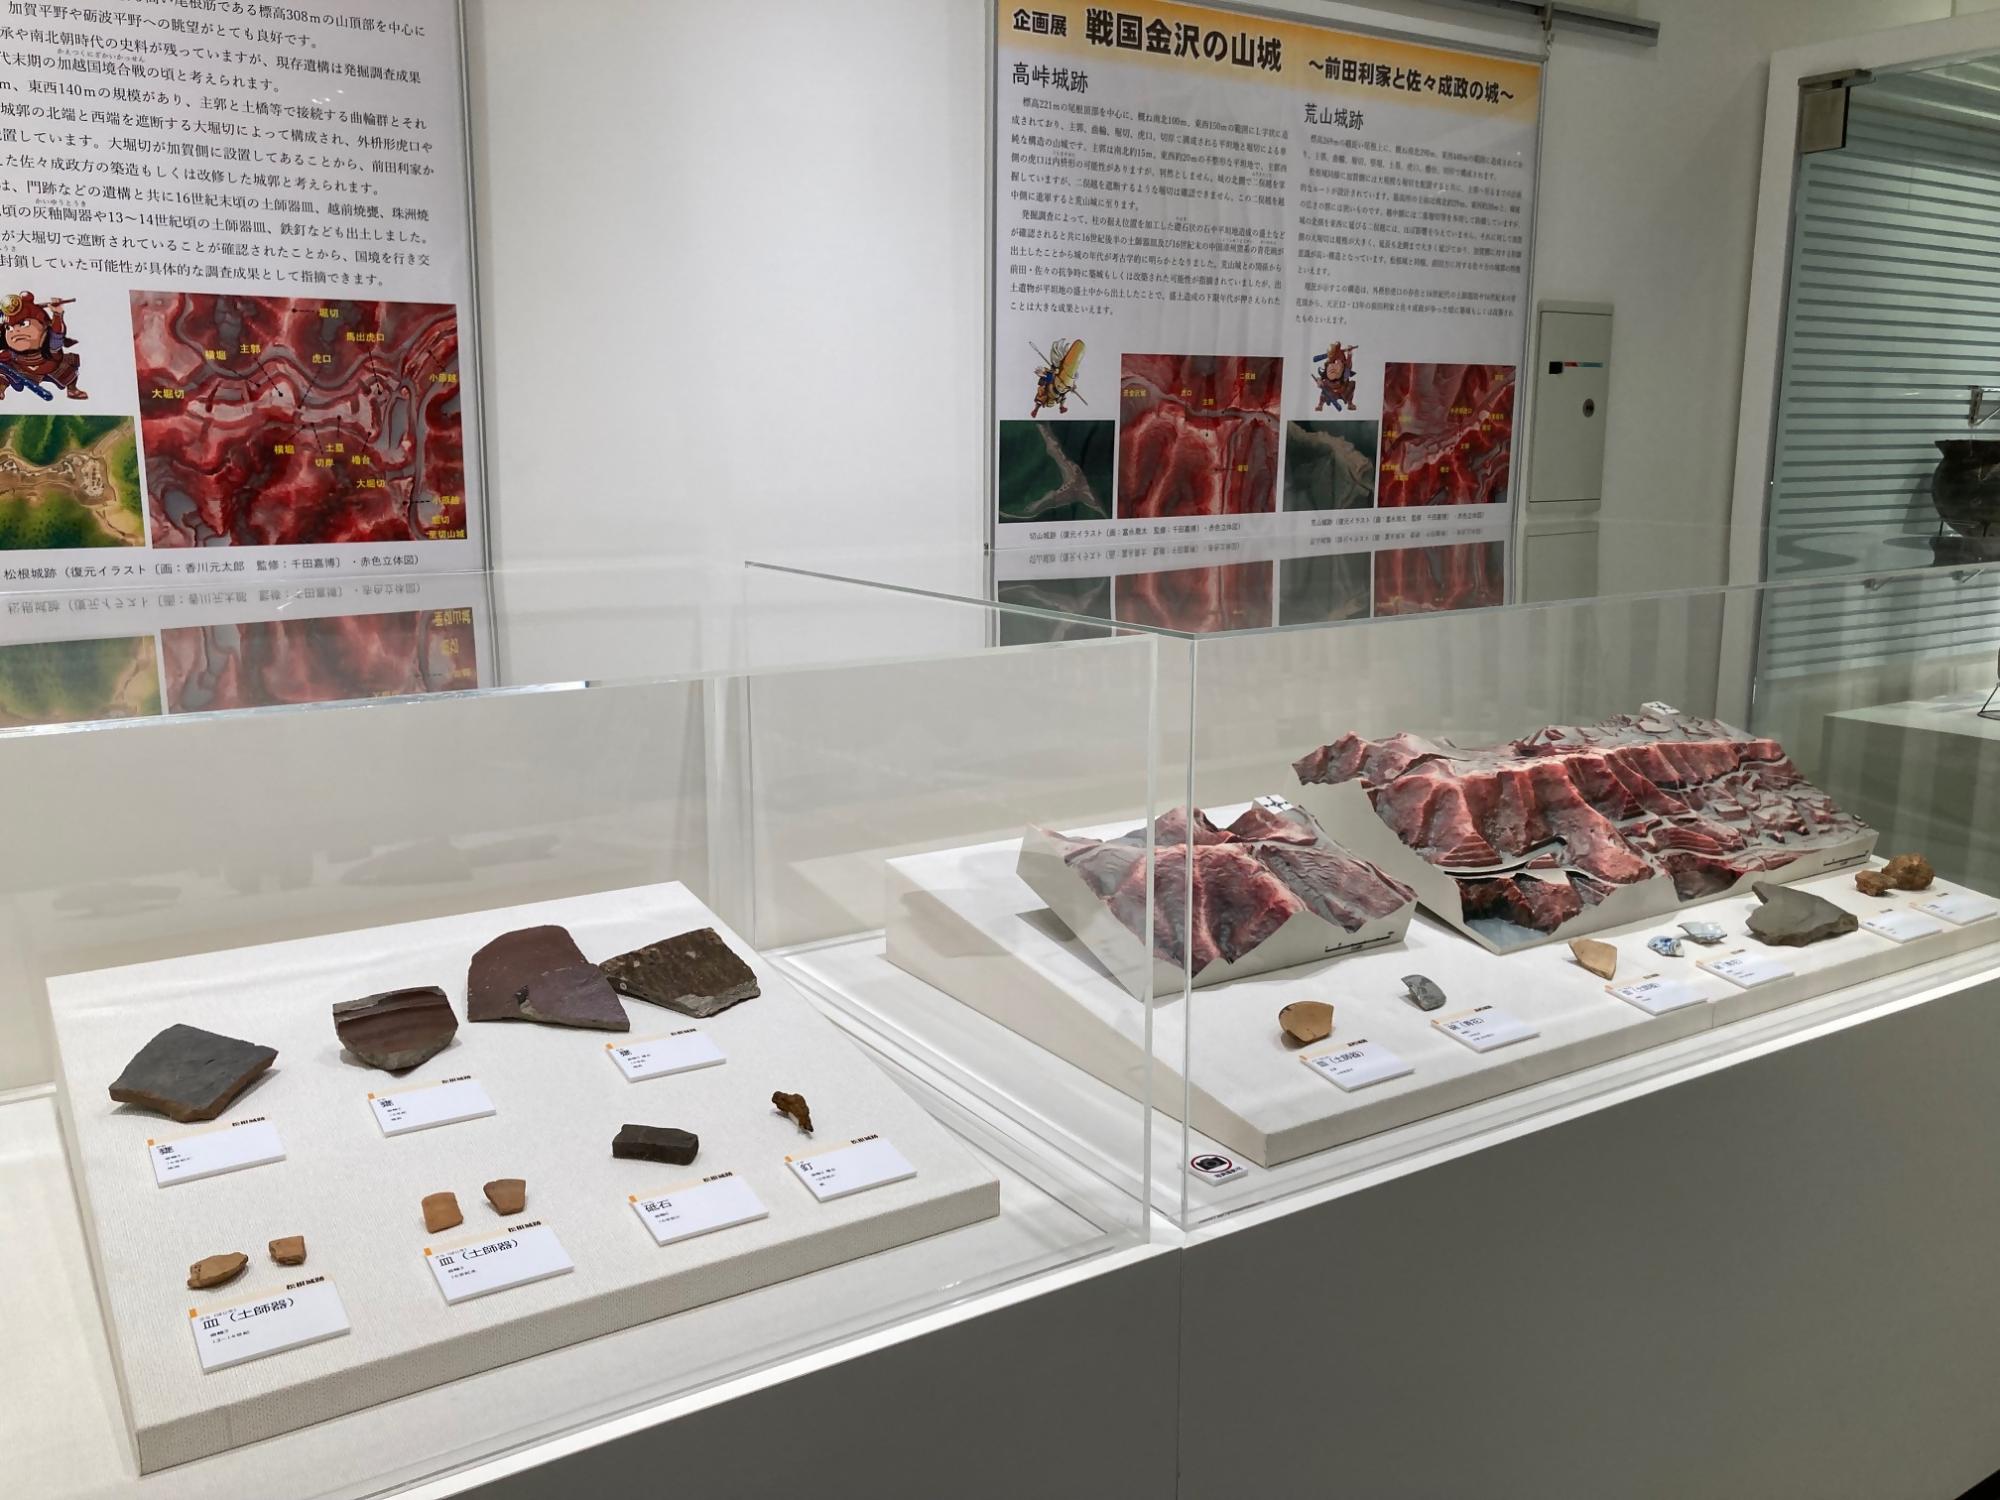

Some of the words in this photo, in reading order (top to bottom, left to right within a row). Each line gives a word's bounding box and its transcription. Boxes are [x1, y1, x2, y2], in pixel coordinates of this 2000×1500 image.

[8, 0, 321, 49] 加賀平野や砺波平野への眺望がとても良好です。
[1013, 8, 1068, 37] 企画展
[1086, 8, 1283, 72] 戦国金沢の山城
[1012, 62, 1089, 94] 高峠城跡
[1303, 103, 1364, 131] 荒山城跡
[0, 152, 381, 196] た佐々成政方の築造もしくは改修した城郭と考えられます。
[0, 204, 428, 244] 頃の灰釉陶器や13～14世紀頃の土師器皿、鉄釘なども出土しました。
[240, 344, 262, 354] 主郭
[312, 354, 332, 364] 虎口
[151, 388, 185, 399] 大堀切
[645, 1200, 672, 1213] 砥石
[439, 1239, 519, 1267] 皿（土師器）
[202, 1297, 295, 1330] 皿（土師器）
